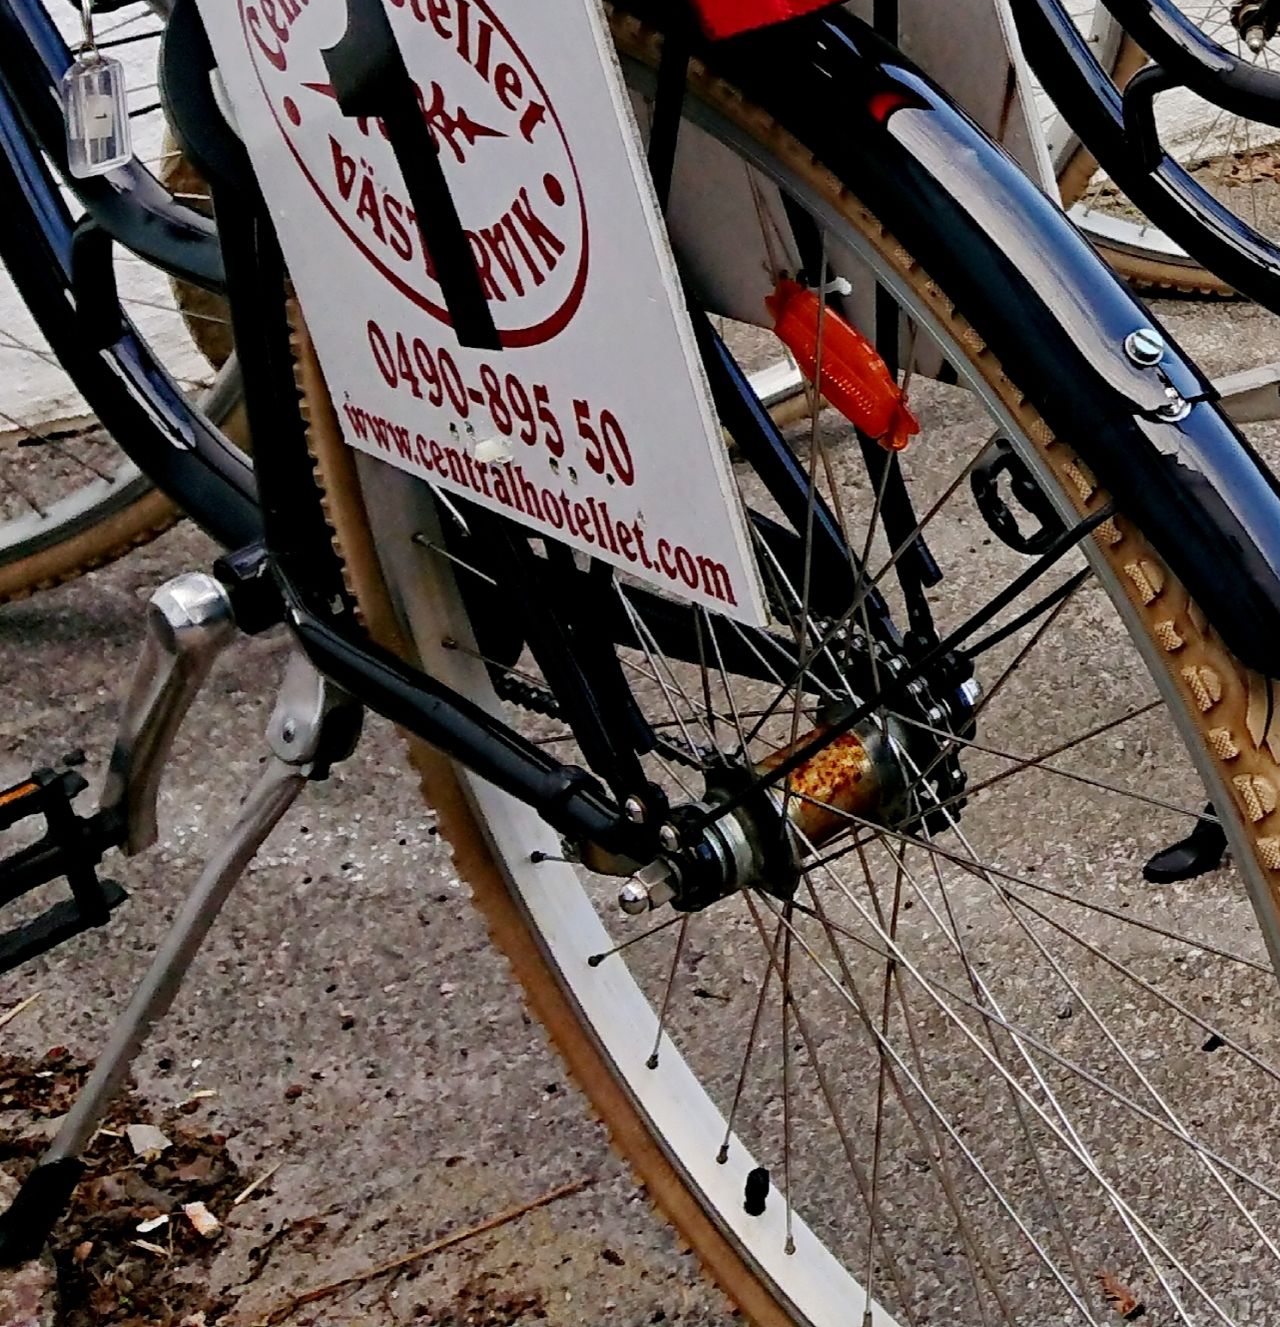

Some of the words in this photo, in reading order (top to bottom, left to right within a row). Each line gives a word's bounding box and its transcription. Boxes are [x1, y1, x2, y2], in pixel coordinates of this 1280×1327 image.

[328, 133, 566, 302] VÄSRVIK
[366, 319, 564, 458] 0490-895
[572, 398, 636, 487] 50
[343, 401, 738, 608] www.centralhotellet.com
